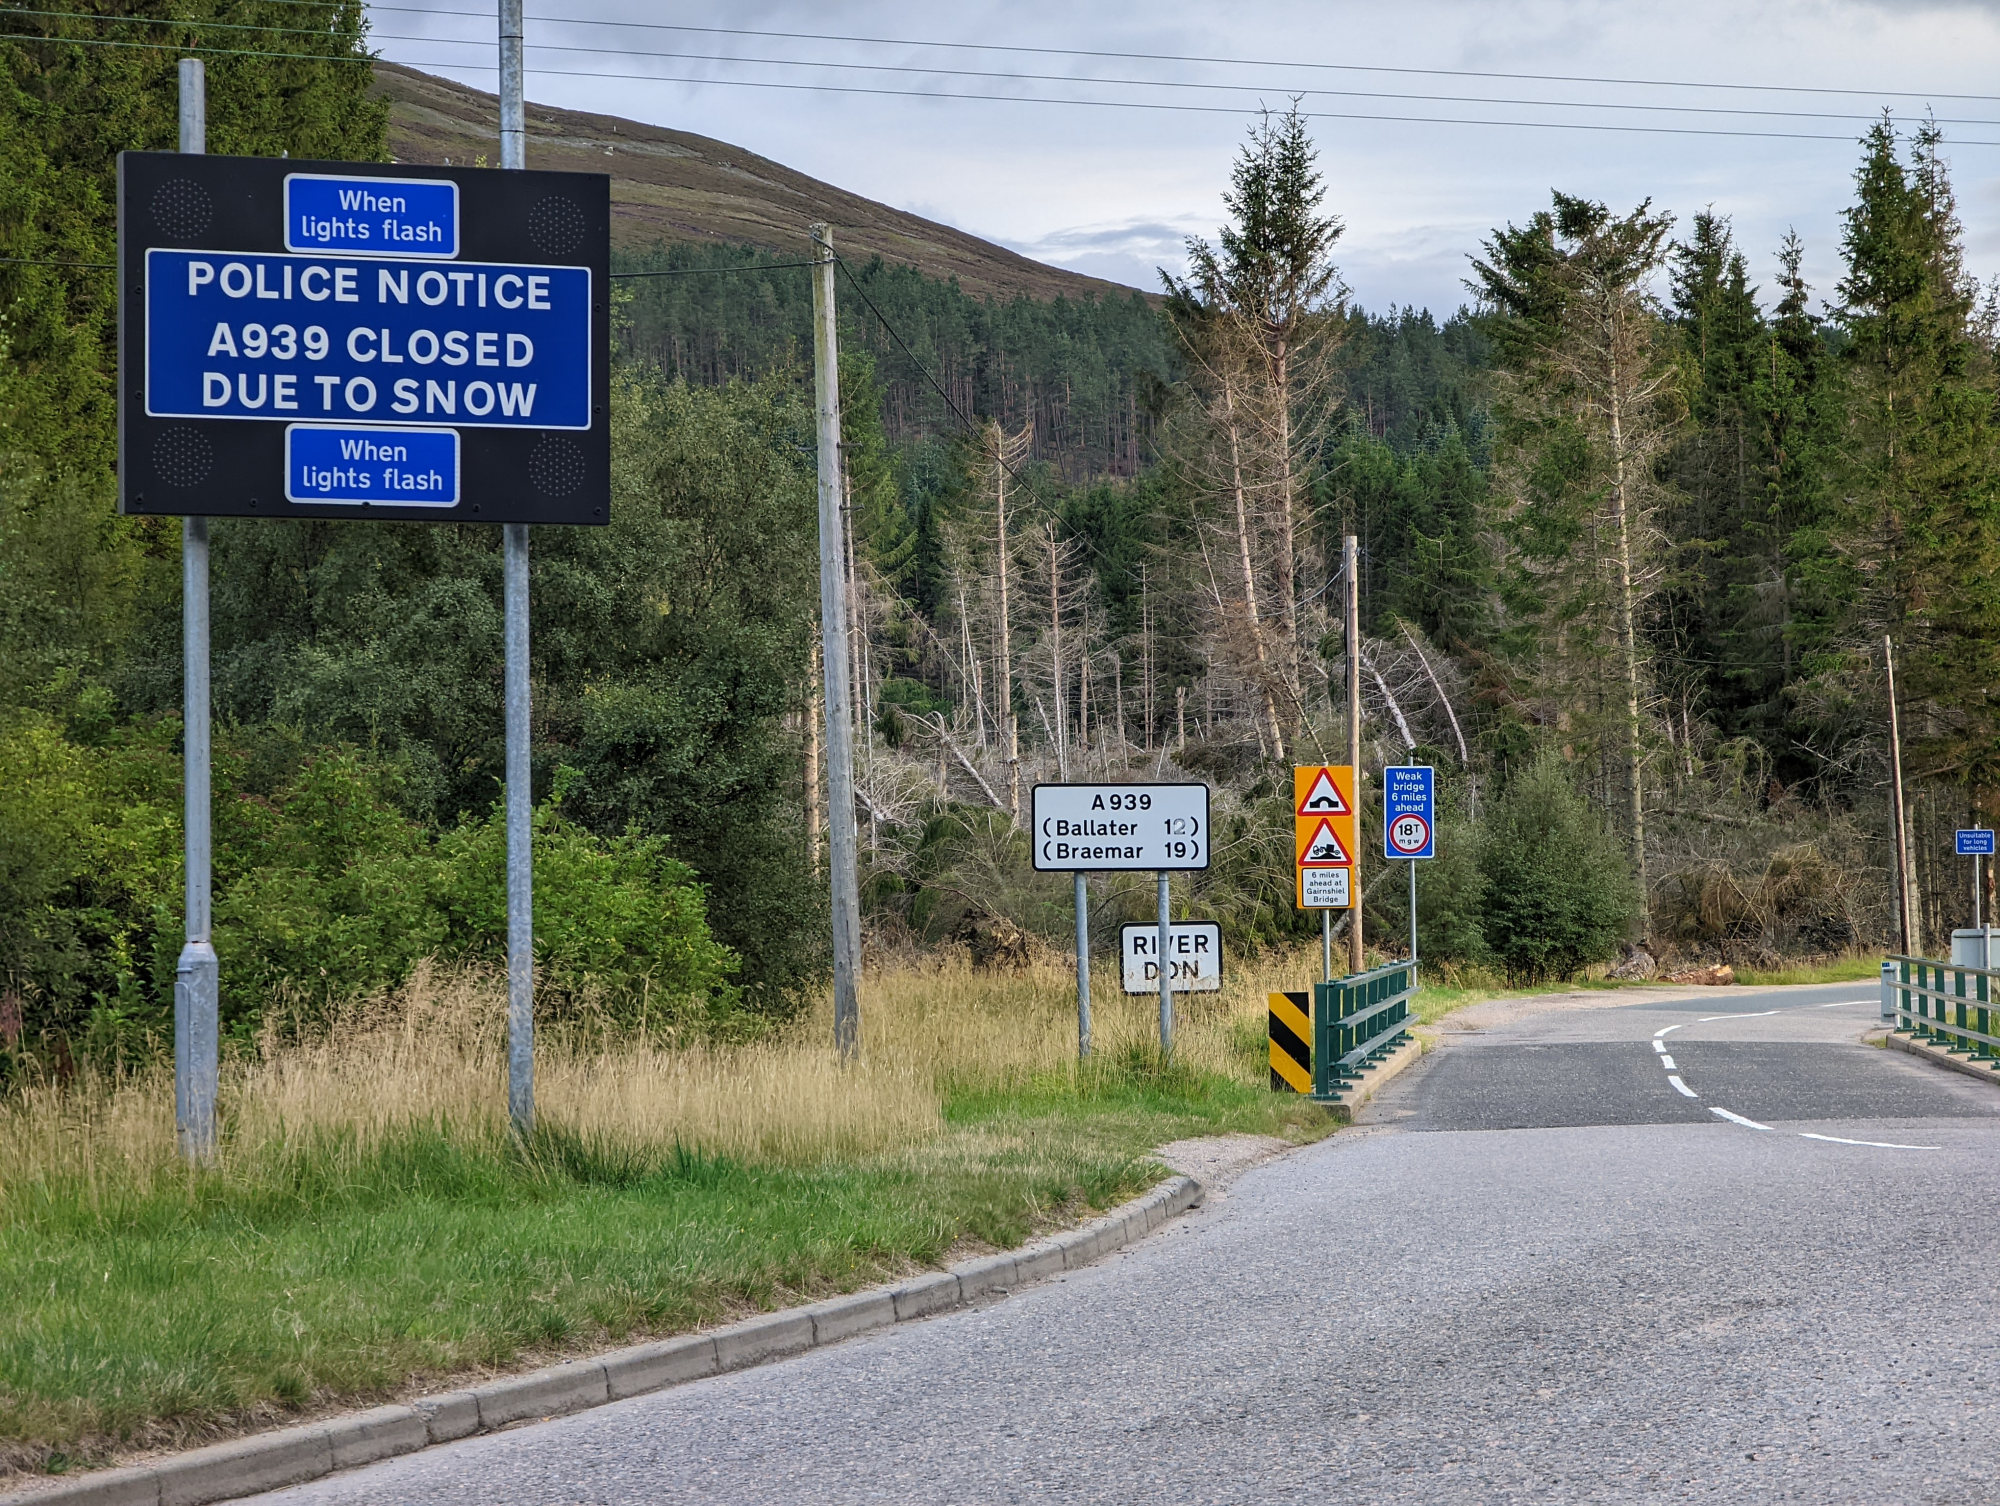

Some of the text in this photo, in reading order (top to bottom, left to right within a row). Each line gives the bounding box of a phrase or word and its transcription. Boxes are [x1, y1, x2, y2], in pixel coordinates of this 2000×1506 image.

[338, 189, 406, 213] When
[302, 216, 441, 242] lights flash
[188, 261, 551, 310] POLICE NOTICE
[207, 322, 534, 368] A939 CLOSED
[202, 372, 537, 417] DUE TO SNOW
[340, 439, 407, 462] When
[303, 466, 442, 491] lights flash
[1394, 783, 1424, 792] bridge
[1396, 772, 1422, 780] Weak
[1092, 794, 1152, 810] A939
[1395, 803, 1423, 811] ahead
[1402, 793, 1427, 801] miles
